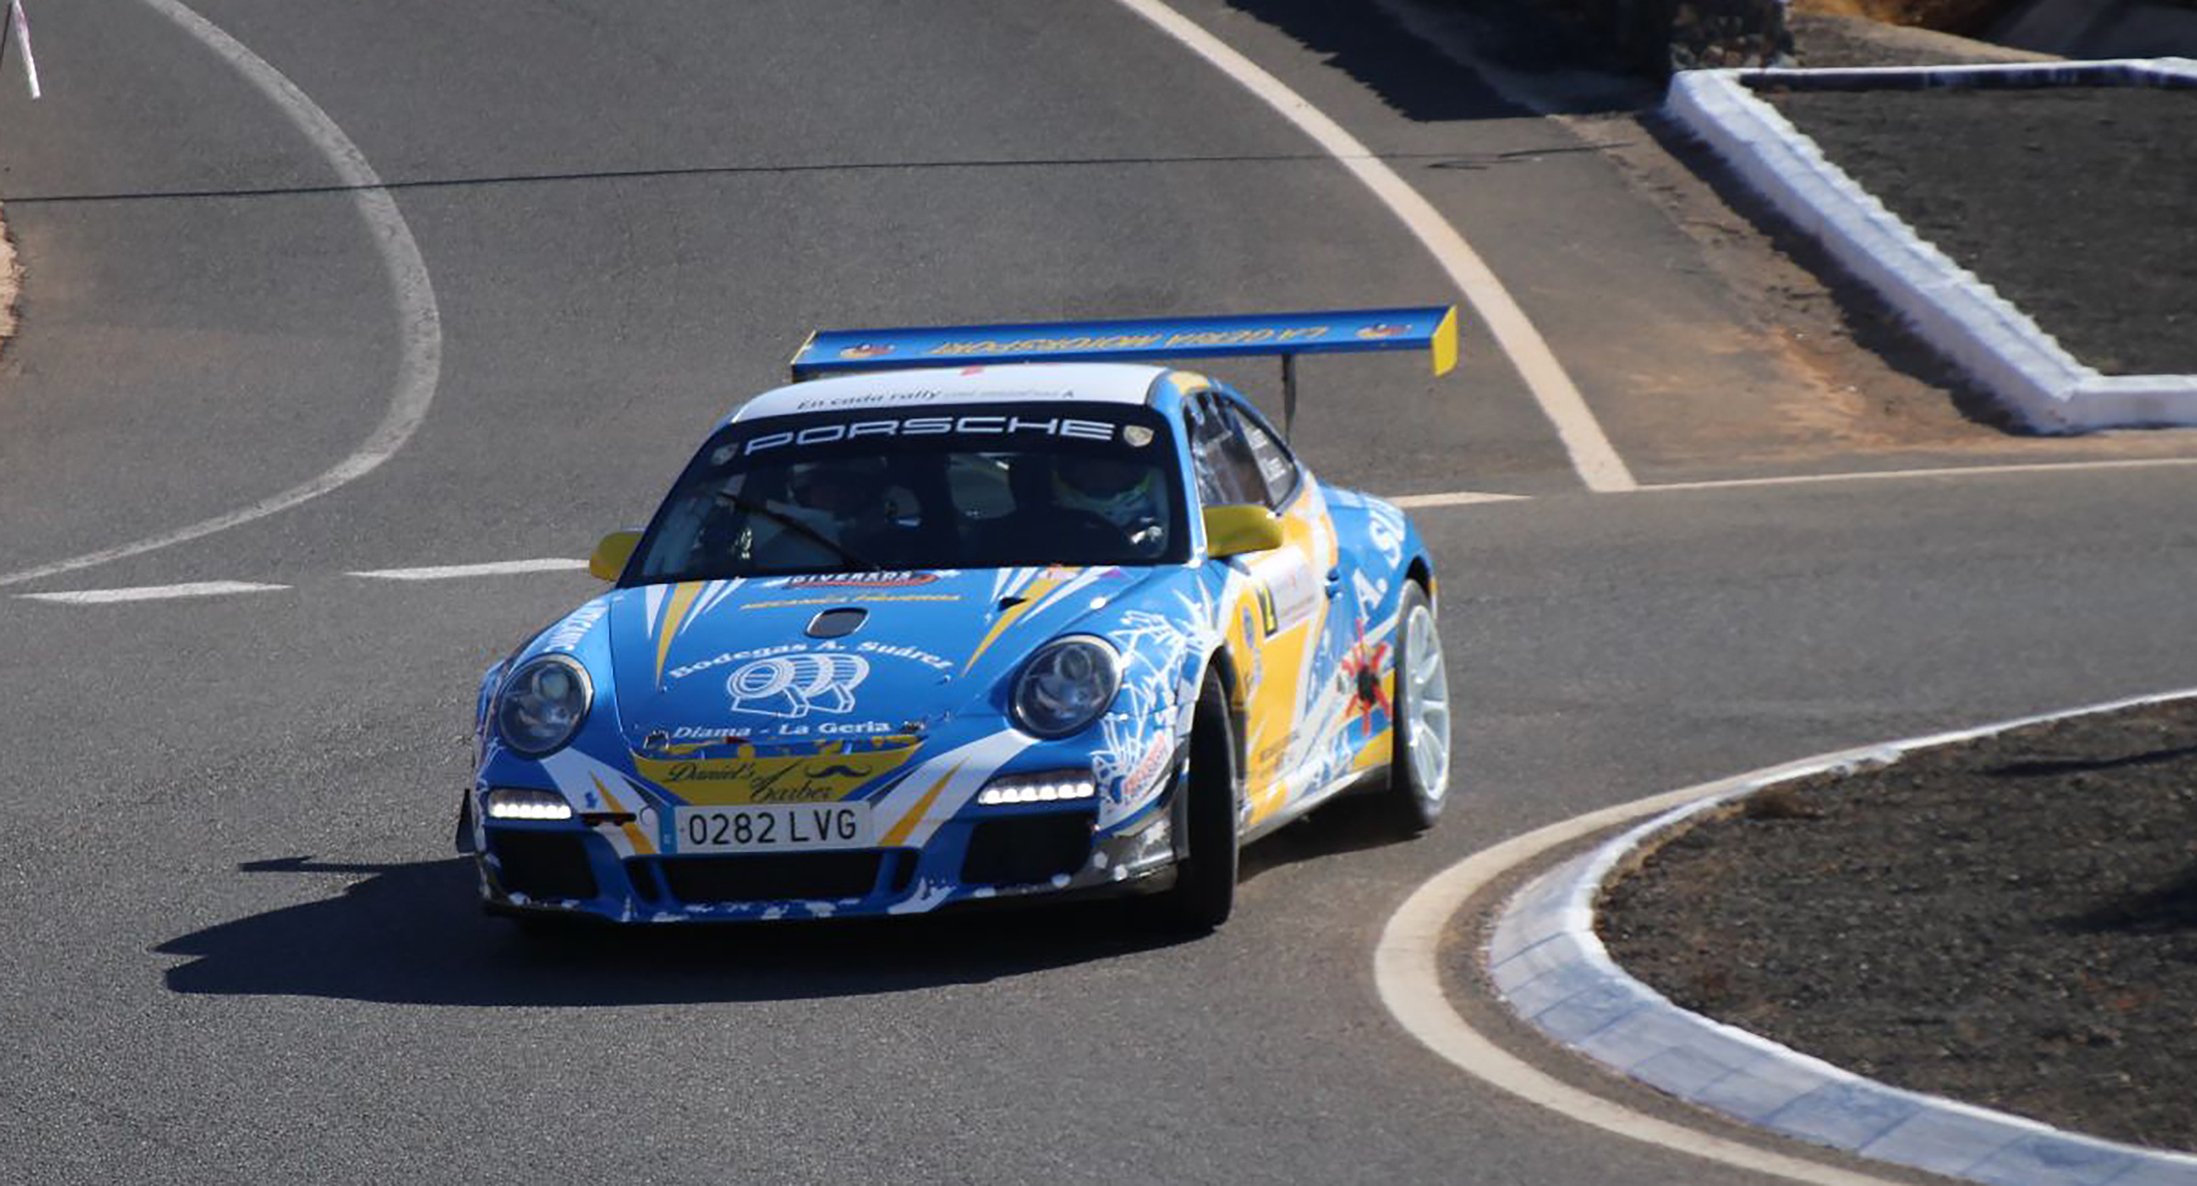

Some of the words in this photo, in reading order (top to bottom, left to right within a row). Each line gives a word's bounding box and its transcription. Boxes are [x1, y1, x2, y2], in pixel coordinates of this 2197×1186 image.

[744, 417, 1115, 456] PORSCHE
[670, 643, 807, 678] Bodegas
[673, 726, 751, 739] Diama
[778, 723, 810, 736] La
[818, 720, 891, 735] Geria
[688, 811, 776, 846] 0282
[789, 808, 857, 843] LVG
